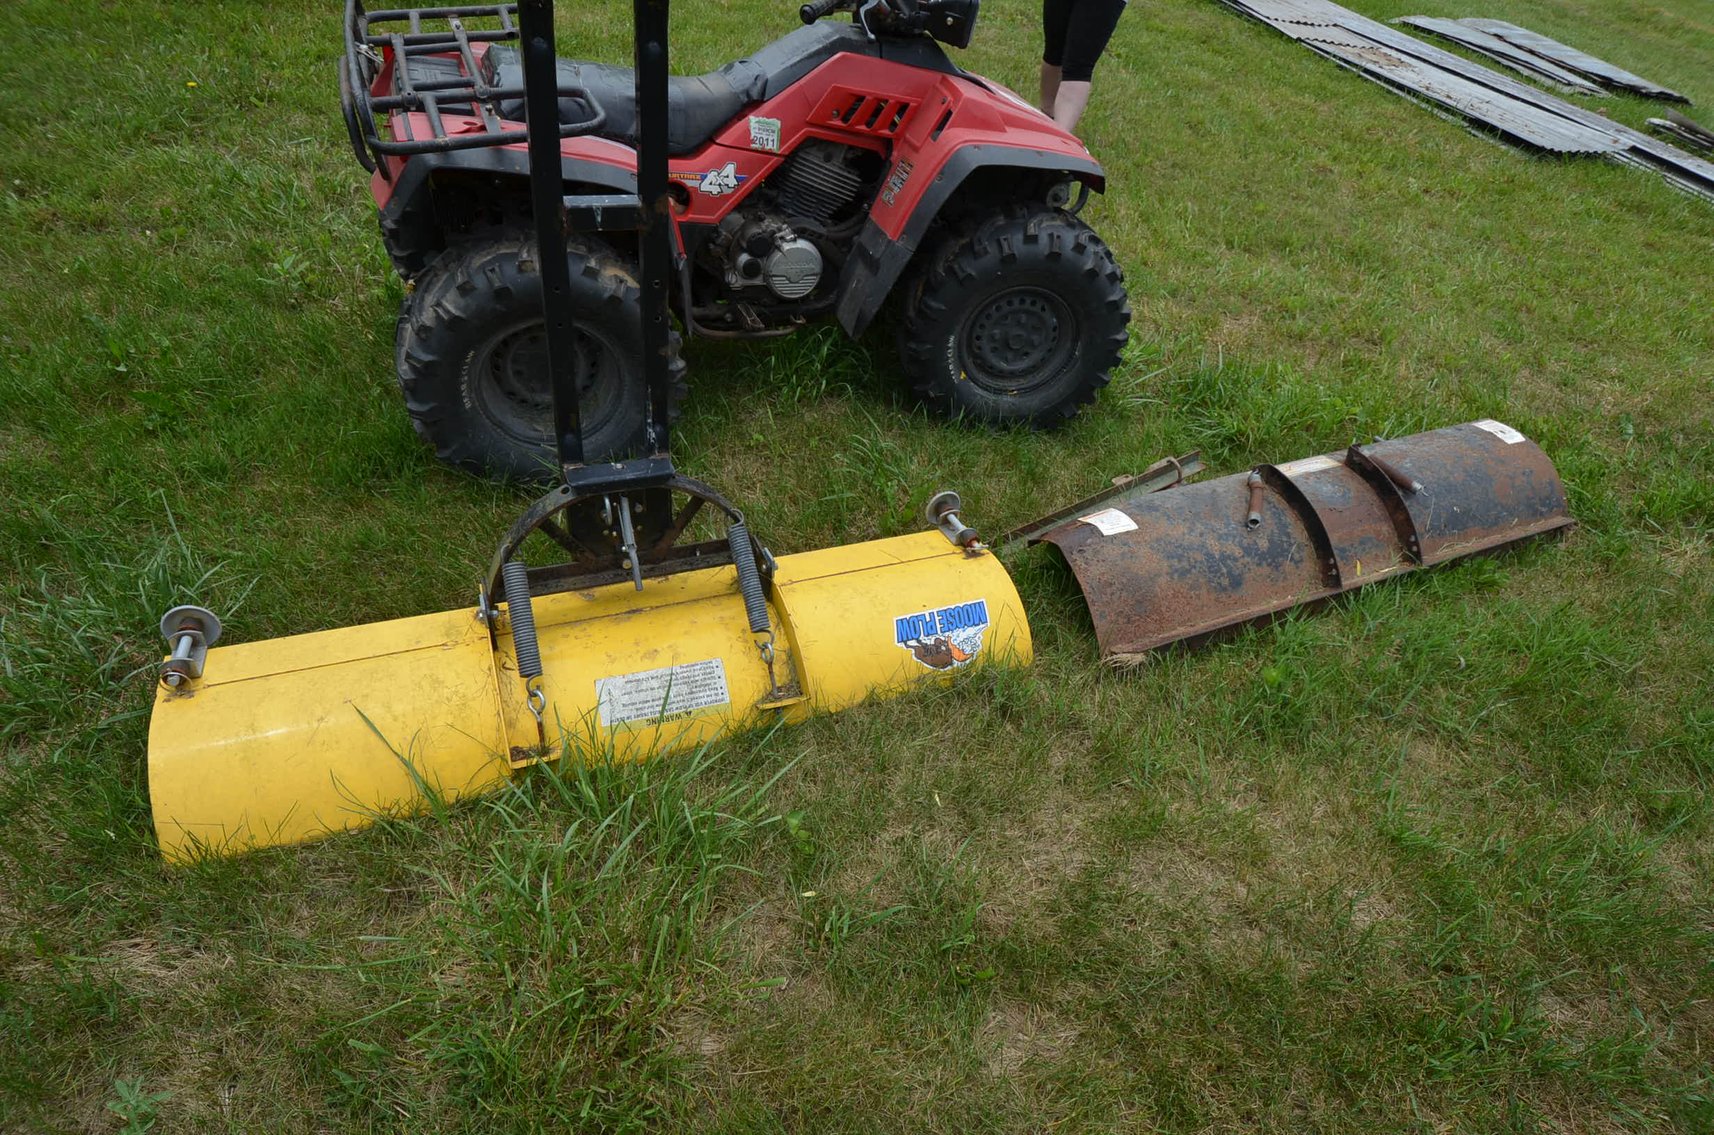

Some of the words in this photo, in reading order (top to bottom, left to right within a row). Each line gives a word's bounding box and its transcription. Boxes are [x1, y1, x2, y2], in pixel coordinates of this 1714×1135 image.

[751, 135, 775, 148] 2011
[896, 612, 938, 643] PLOW
[937, 601, 988, 633] MOOSE
